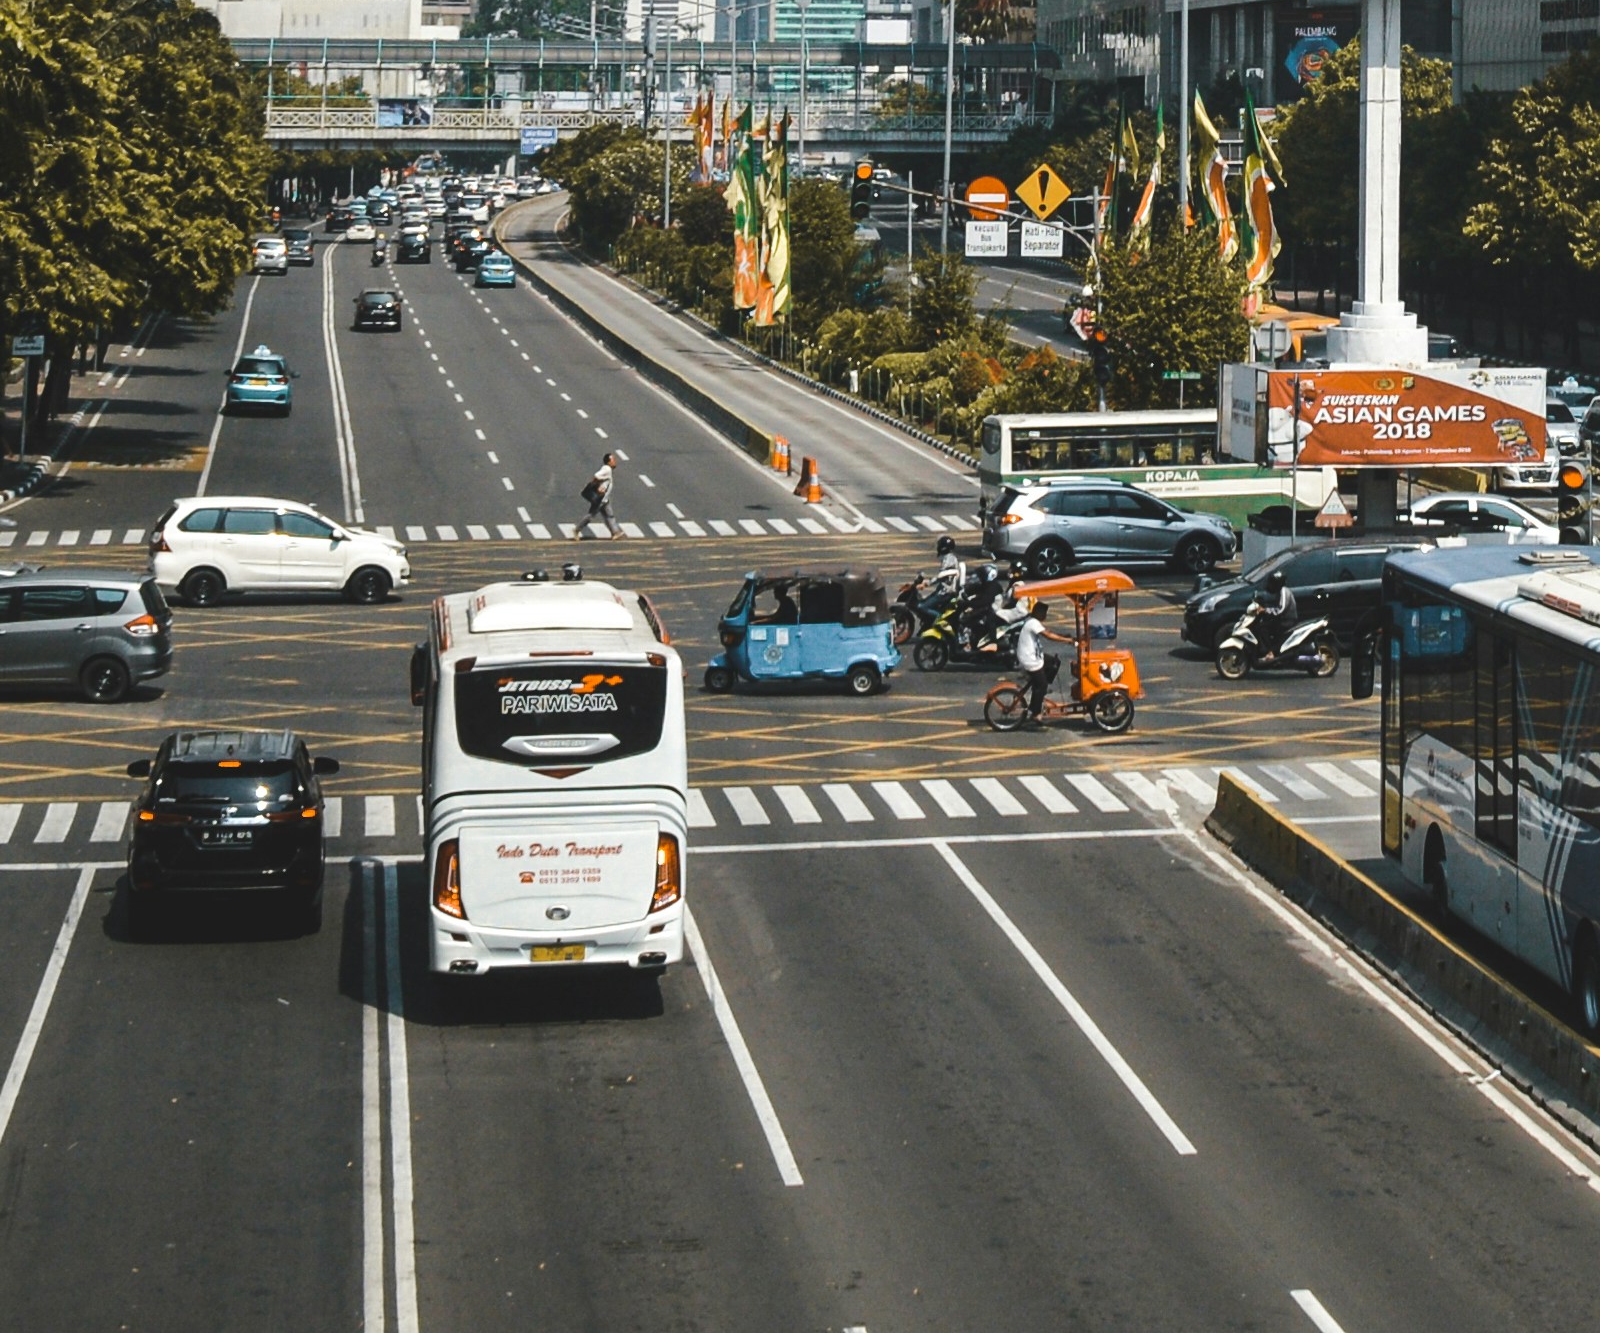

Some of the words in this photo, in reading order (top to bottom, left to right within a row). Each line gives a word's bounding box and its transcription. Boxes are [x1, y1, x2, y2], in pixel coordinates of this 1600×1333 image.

[1321, 394, 1400, 407] SUKSESKAN
[1313, 406, 1395, 425] ASIAN
[1397, 404, 1487, 423] GAMES
[1372, 422, 1432, 440] 2018
[501, 693, 618, 714] PARIWISATA
[496, 844, 524, 859] Indo
[529, 842, 560, 857] Duta
[565, 841, 623, 859] Transport
